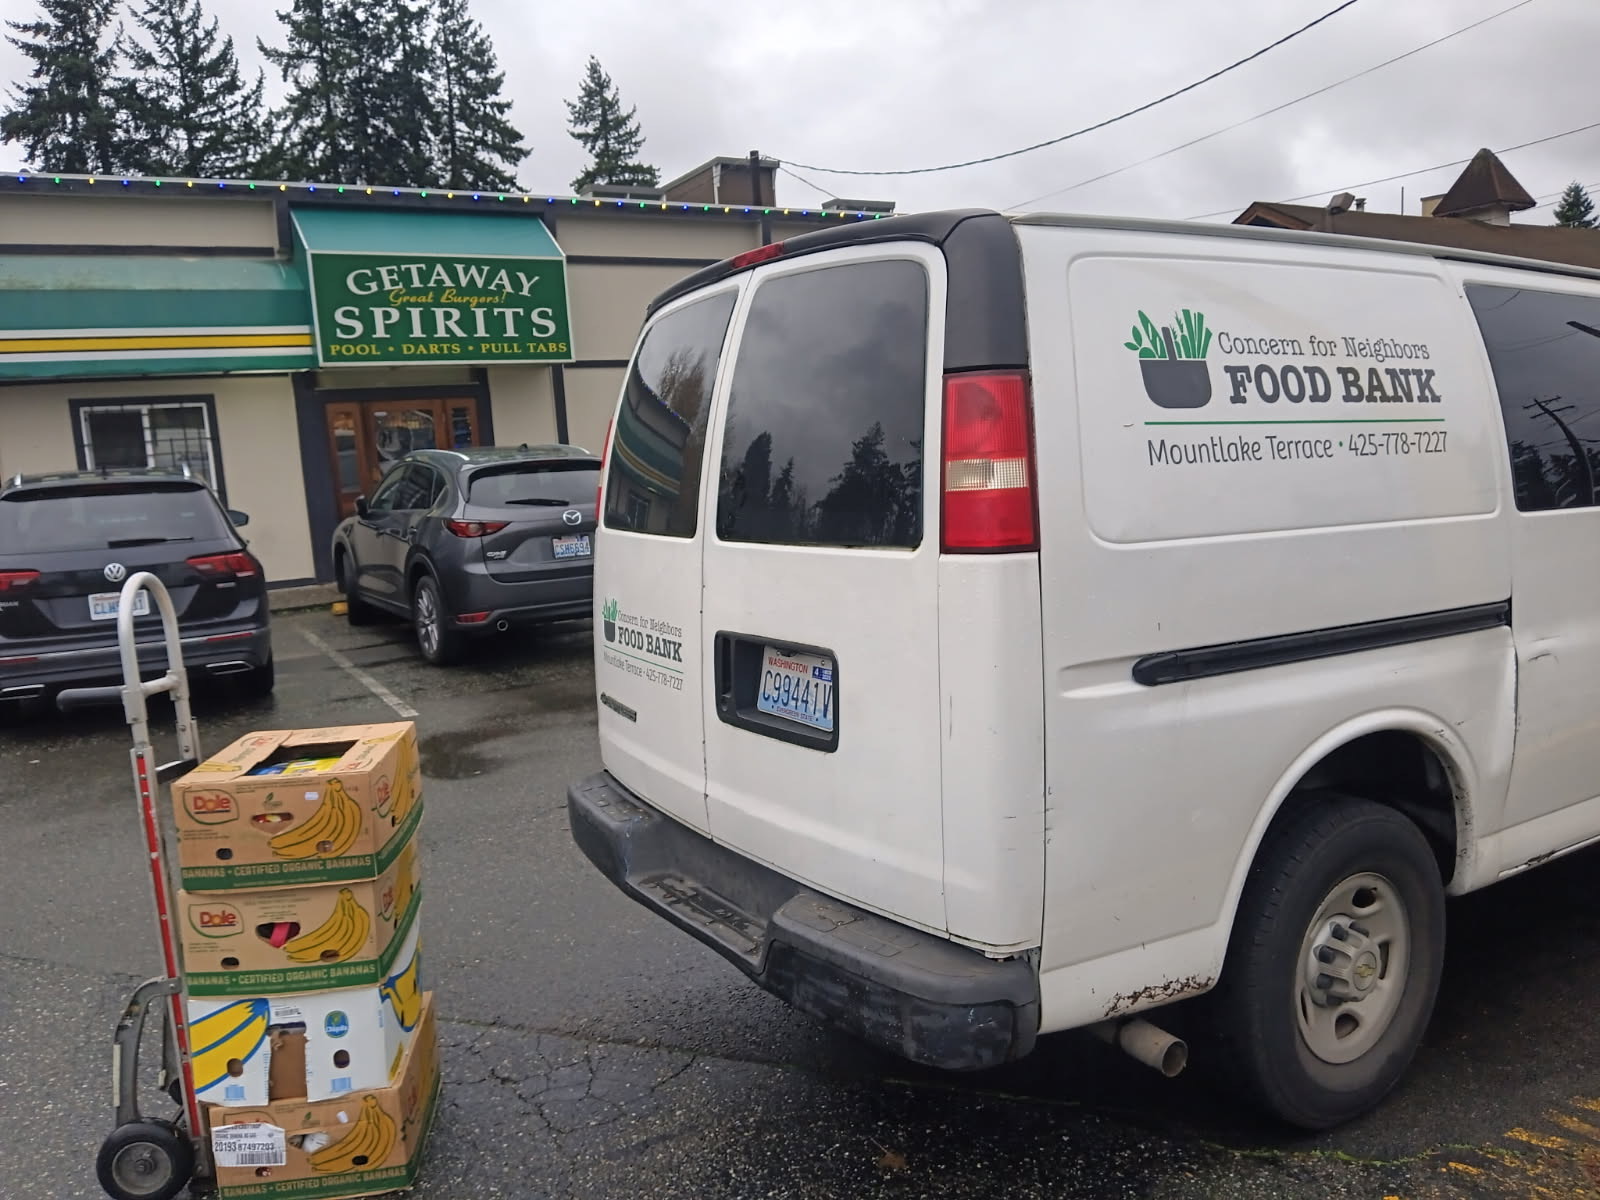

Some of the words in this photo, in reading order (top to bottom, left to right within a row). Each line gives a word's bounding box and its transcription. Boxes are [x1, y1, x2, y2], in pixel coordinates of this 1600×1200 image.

[346, 263, 540, 297] GETAWAY
[389, 288, 433, 307] Great
[440, 289, 507, 308] Burgers!
[334, 306, 556, 339] SPIRITS
[330, 344, 381, 355] POOL
[402, 343, 461, 355] DARTS
[481, 342, 522, 354] PULL
[527, 342, 567, 353] TABS
[1218, 332, 1304, 356] Concern
[1309, 336, 1337, 357] for
[1341, 337, 1430, 362] Neighbors
[1224, 364, 1332, 404] FOOD
[1337, 366, 1442, 403] BANK
[1147, 436, 1262, 466] Mountlake
[1265, 435, 1333, 460] Terrace
[1348, 431, 1447, 456] 425-778-7227
[618, 626, 643, 650] FOOD
[646, 633, 682, 663] BANK
[768, 656, 808, 674] WASHINGTON
[763, 670, 832, 719] C99441V
[193, 795, 231, 812] Dole
[183, 868, 225, 878] BANANAS
[234, 864, 279, 877] CERTIFIED
[282, 860, 324, 873] ORGANIC
[326, 856, 371, 869] BANANAS
[200, 911, 236, 926] Dole
[239, 972, 283, 984] CERTIFIED
[286, 968, 327, 982] ORGANIC
[330, 963, 375, 978] BANANAS
[275, 1179, 319, 1192] CERTIFIED
